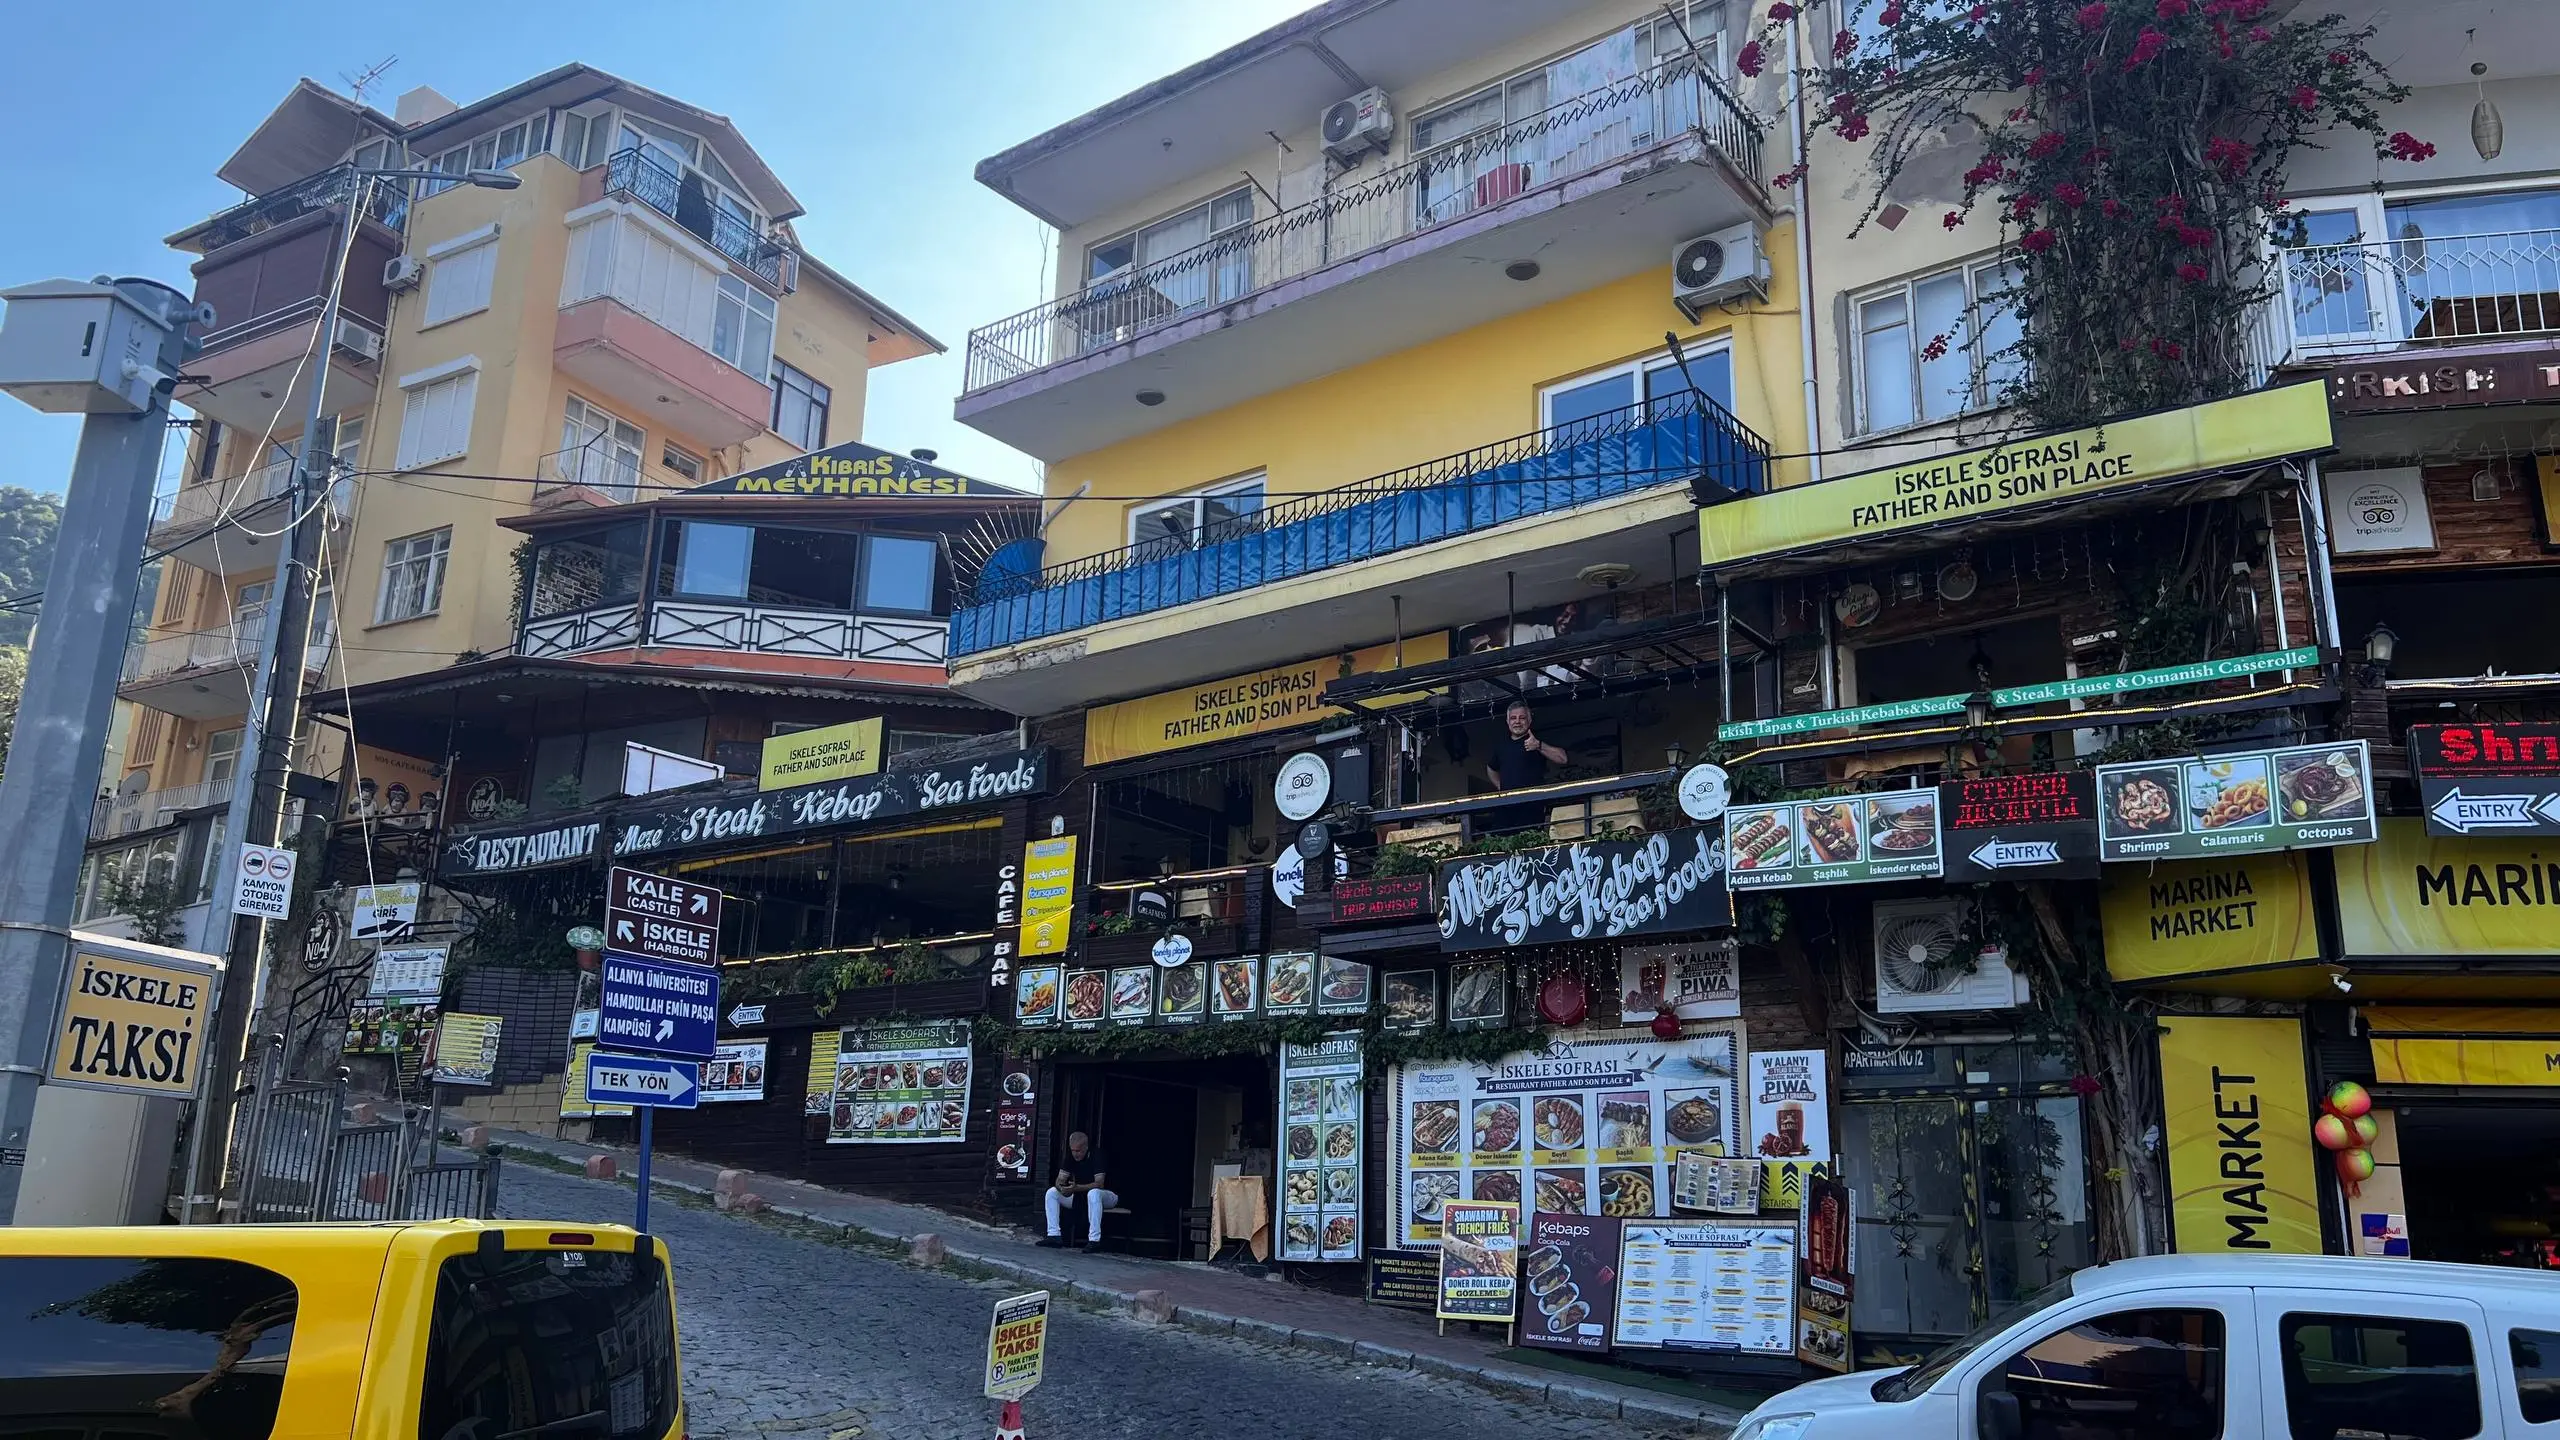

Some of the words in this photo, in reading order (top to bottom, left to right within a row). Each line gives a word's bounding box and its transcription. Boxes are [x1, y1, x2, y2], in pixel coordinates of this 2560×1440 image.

[1895, 461, 1973, 495] İSKELE
[1979, 440, 2080, 478] SOFRASI
[1852, 493, 1938, 527] FATHER
[1944, 483, 1992, 510] AND
[1998, 472, 2047, 499] SON
[2053, 454, 2133, 488] PLACE
[1194, 685, 1246, 713] İSKELE
[1250, 670, 1316, 700] SOFRASI
[1756, 722, 1793, 736] Tapas
[1796, 719, 1806, 729] &
[1809, 711, 1860, 728] Turkish
[1996, 693, 2008, 704] &
[2012, 686, 2055, 702] Steak
[2062, 678, 2111, 696] Hause
[2116, 677, 2128, 687] &
[2131, 665, 2214, 687] Osmanish
[2219, 652, 2308, 674] Casserolle
[1164, 714, 1221, 740] FATHER
[1224, 707, 1256, 728] AND
[1260, 700, 1292, 721] SON
[817, 740, 851, 756] SOFRASI
[773, 761, 802, 776] FATHER
[804, 758, 820, 770] AND
[822, 755, 838, 767] SON
[840, 750, 866, 764] PLACE
[475, 823, 600, 871] RESTAURANT
[614, 825, 664, 856] Meze
[680, 799, 766, 843] Steak
[792, 784, 883, 824] Kebap
[920, 771, 964, 809] Sea
[967, 758, 1036, 799] Foods
[2458, 803, 2514, 818] ENTRY
[2201, 833, 2265, 847] Calamaris
[2297, 826, 2353, 840] Octopus
[1996, 845, 2042, 860] ENTRY
[2120, 840, 2170, 853] Shrimps
[1870, 864, 1909, 874] İskender
[1910, 862, 1938, 873] Kebab
[242, 878, 285, 892] KAMYON
[1559, 832, 1670, 939] Kebap
[1730, 873, 1761, 884] Adana
[1762, 872, 1793, 883] Kebab
[626, 876, 684, 903] KALE
[997, 865, 1016, 924] CAFE
[1028, 887, 1066, 898] foursquare
[1440, 852, 1528, 939] Meze
[1492, 842, 1604, 946] Steak
[2150, 869, 2253, 909] MARİNA
[239, 898, 283, 913] GİREMEZ
[627, 896, 680, 917] (CASTLE)
[2150, 902, 2257, 941] MARKET
[643, 918, 710, 949] İSKELE
[644, 941, 707, 961] (HARBOUR)
[1689, 950, 1730, 963] ALANYI
[991, 942, 1012, 987] BAR
[80, 960, 197, 1010] İSKELE
[607, 966, 644, 987] ALANYA
[647, 970, 709, 996] ÜNİVERSİTESİ
[1680, 976, 1730, 996] PIWA
[606, 991, 664, 1016] HAMDULLAH
[665, 999, 690, 1018] EMİN
[691, 1005, 714, 1025] PAŞA
[738, 1010, 759, 1020] ENTRY
[1268, 1008, 1287, 1016] Adana
[603, 1017, 651, 1038] KAMPÜSÜ
[1072, 1022, 1095, 1030] Shrimps
[1168, 1015, 1193, 1024] Octopus
[68, 1016, 194, 1084] TAKSİ
[1501, 1063, 1550, 1079] İSKELE
[1555, 1060, 1618, 1076] SOFRASI
[1761, 1058, 1773, 1068] W
[1774, 1056, 1809, 1066] ALANYI
[600, 1072, 629, 1087] TEK
[638, 1073, 669, 1091] YÖN
[1495, 1080, 1536, 1090] RESTAURANT
[1541, 1080, 1567, 1088] FATHER
[1764, 1080, 1810, 1095] PIWA
[2212, 1066, 2271, 1249] MARKET
[1454, 1210, 1499, 1222] SHAWARMA
[1501, 1209, 1508, 1221] &
[1456, 1222, 1487, 1235] FRENCH
[1487, 1222, 1510, 1234] FRIES
[1538, 1221, 1590, 1237] Kebaps
[1472, 1279, 1488, 1288] ROLL
[1489, 1279, 1510, 1288] KEBAP
[1007, 1357, 1021, 1367] PARK
[1022, 1353, 1039, 1363] ETMEK
